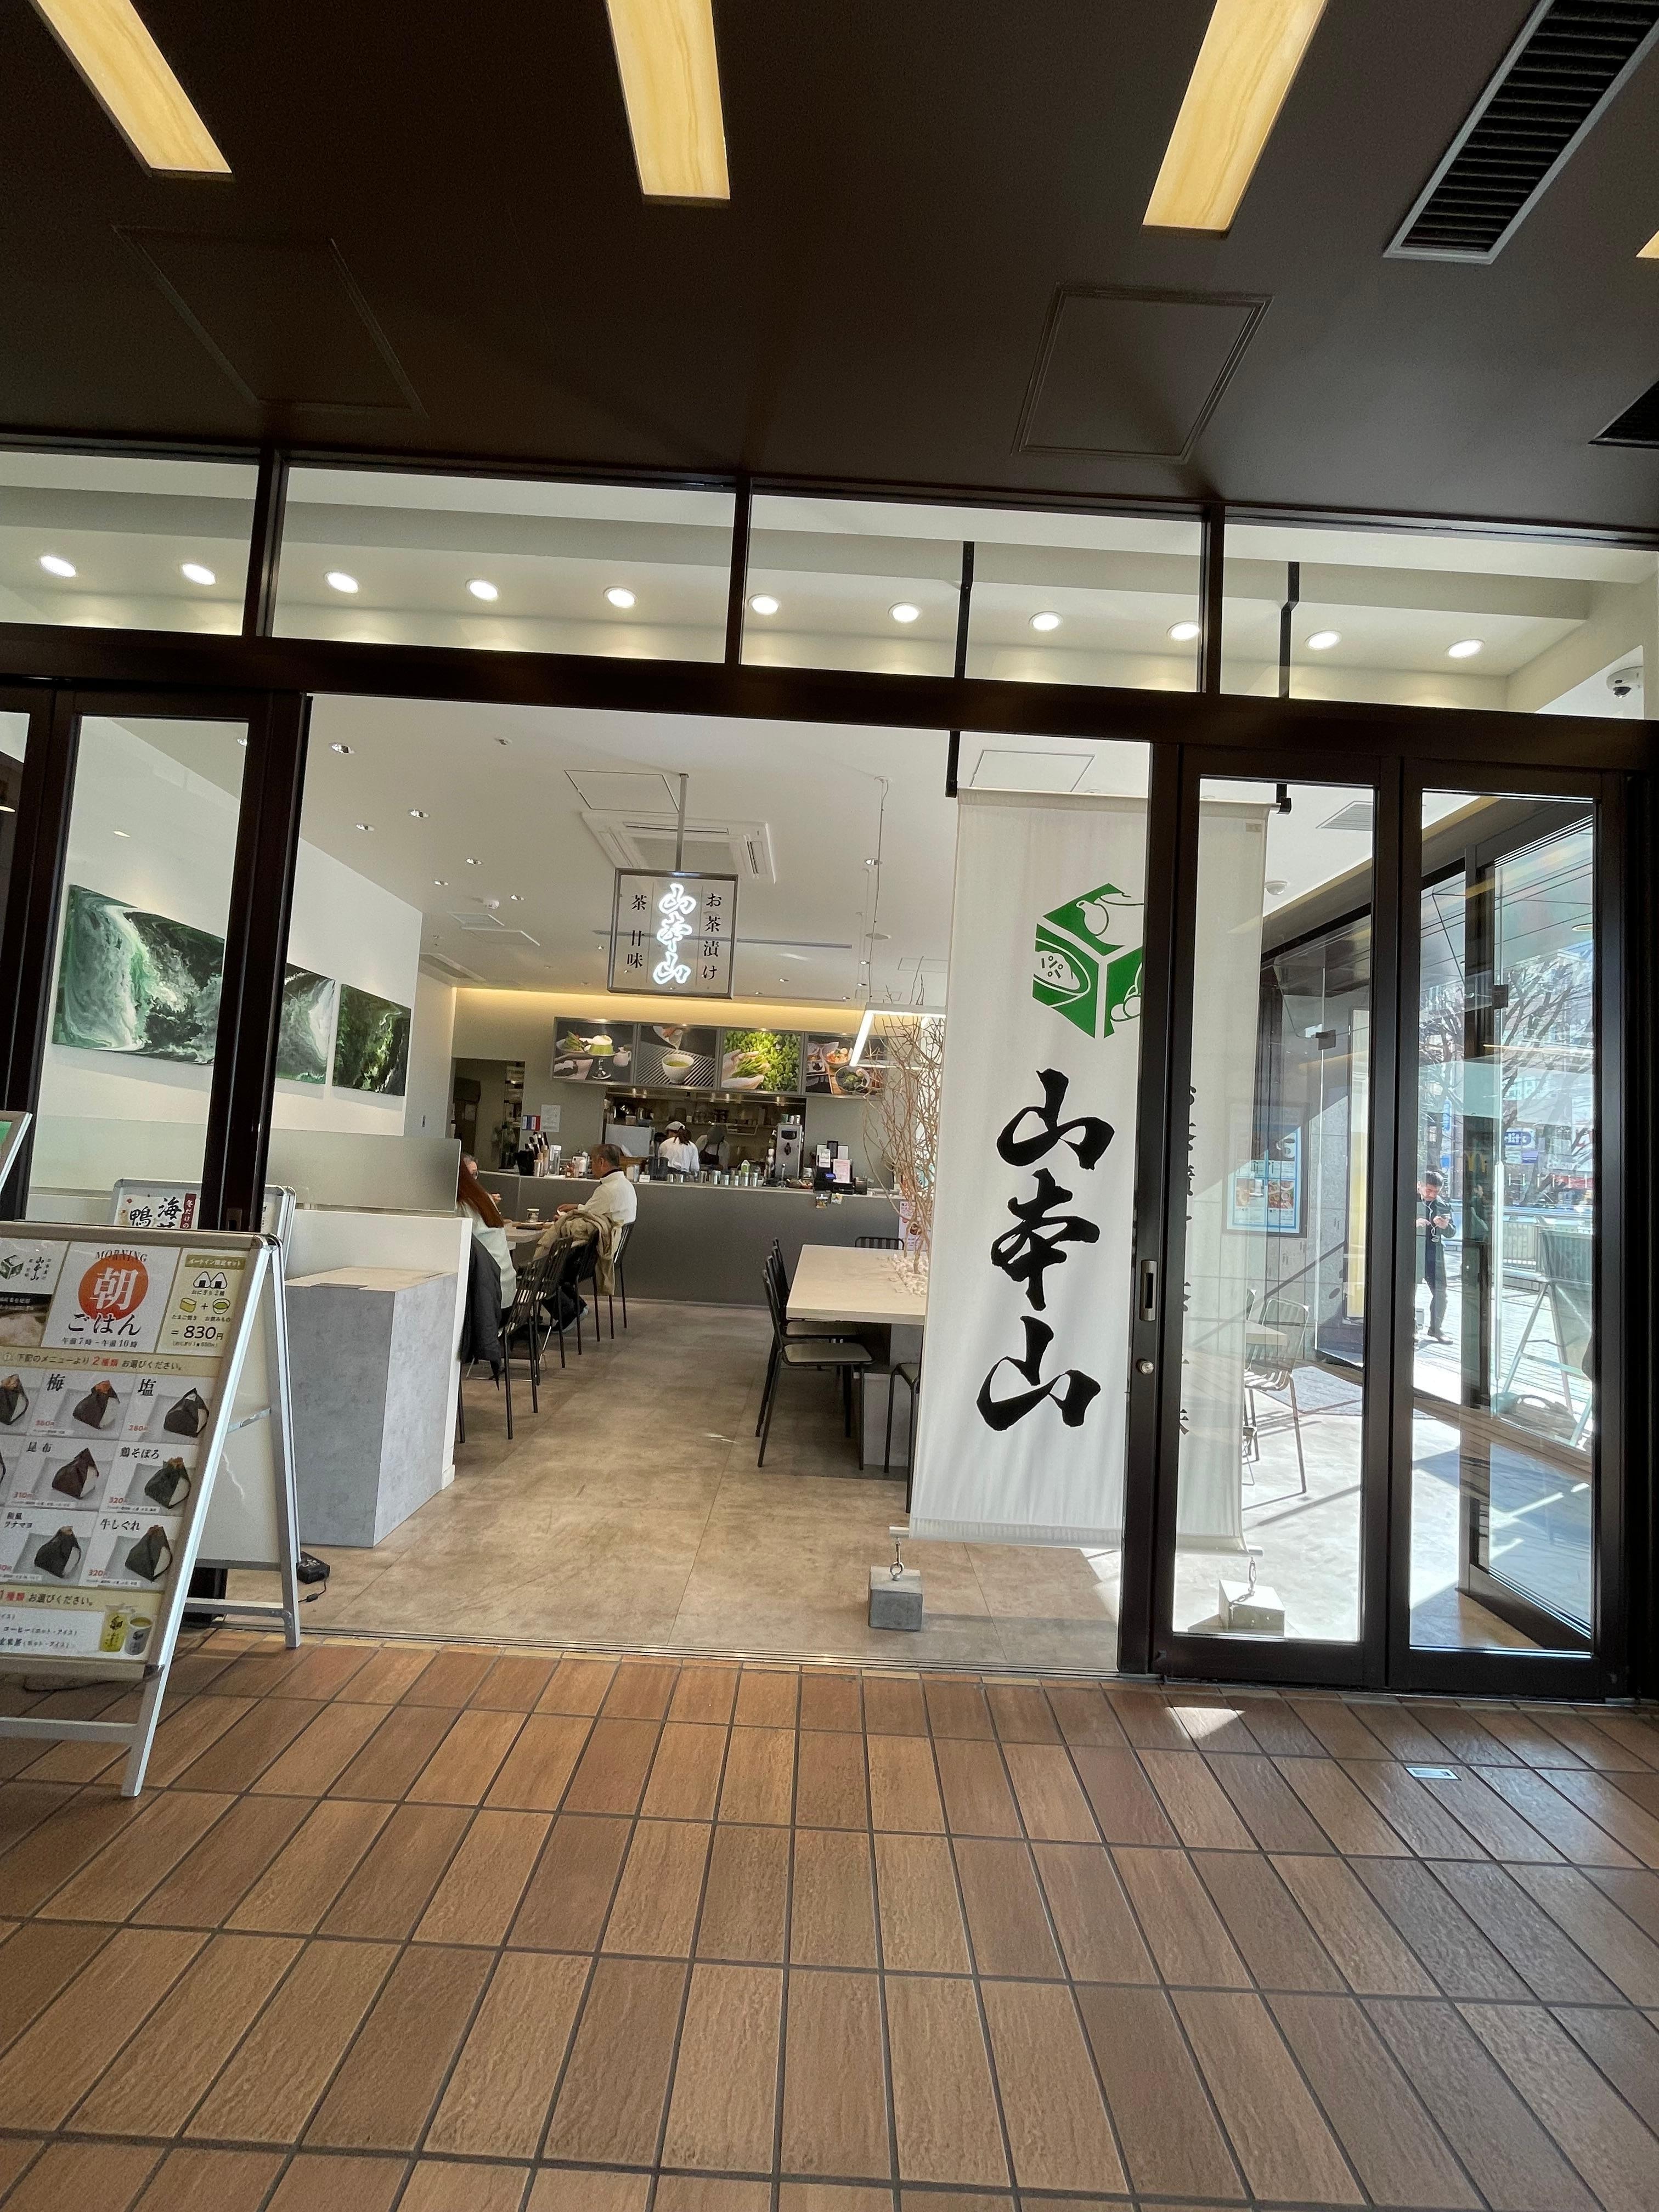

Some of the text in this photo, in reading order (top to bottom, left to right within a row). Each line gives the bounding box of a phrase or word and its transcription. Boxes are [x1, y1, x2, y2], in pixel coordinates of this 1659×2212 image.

[653, 883, 697, 985] 山本山
[703, 893, 722, 980] お茶漬け
[157, 1197, 182, 1228] 海
[95, 1249, 148, 1262] MORNING
[977, 1068, 1115, 1431] 山本山
[89, 1267, 139, 1311] 朝
[68, 1313, 142, 1336] ごはん
[183, 1325, 224, 1341] 830円
[47, 1373, 65, 1391] 梅
[138, 1378, 157, 1397] 塩
[100, 1518, 141, 1531] 牛しぐれ
